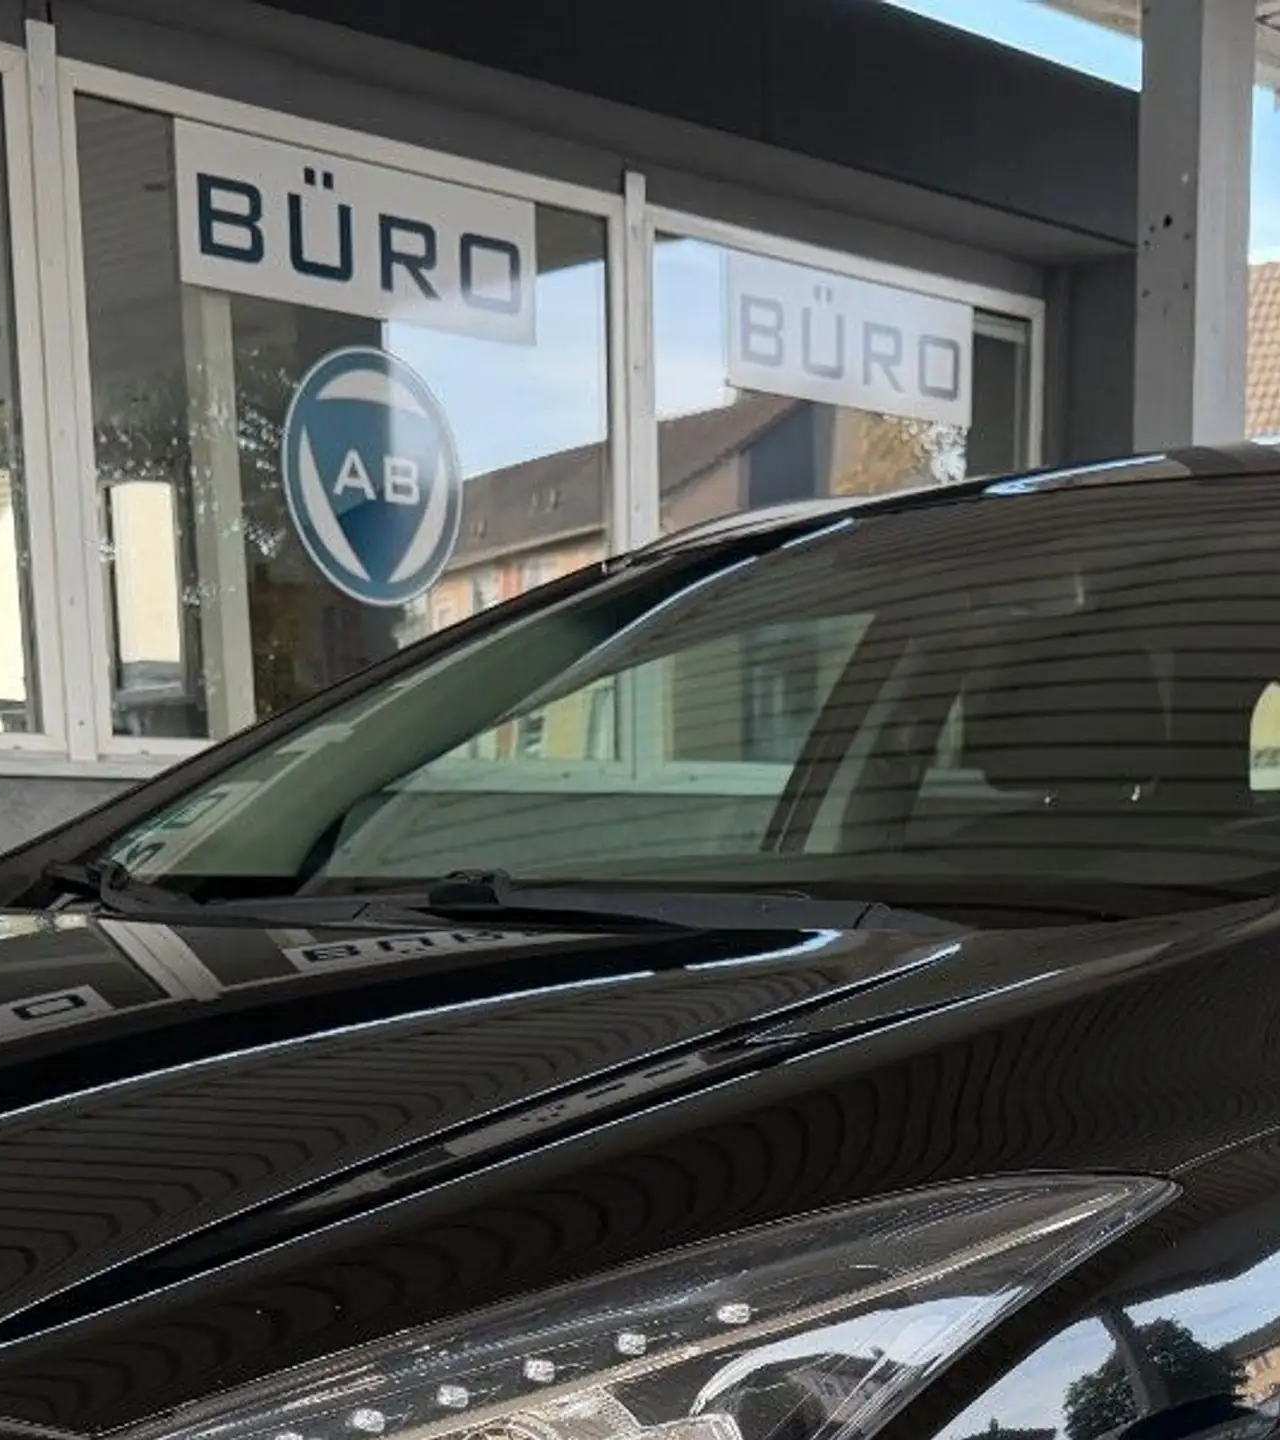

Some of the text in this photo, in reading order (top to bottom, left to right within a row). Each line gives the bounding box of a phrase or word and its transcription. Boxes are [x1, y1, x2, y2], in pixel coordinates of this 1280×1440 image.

[196, 167, 520, 316] BÜRO
[740, 284, 961, 402] BÜRO
[333, 449, 421, 506] AB
